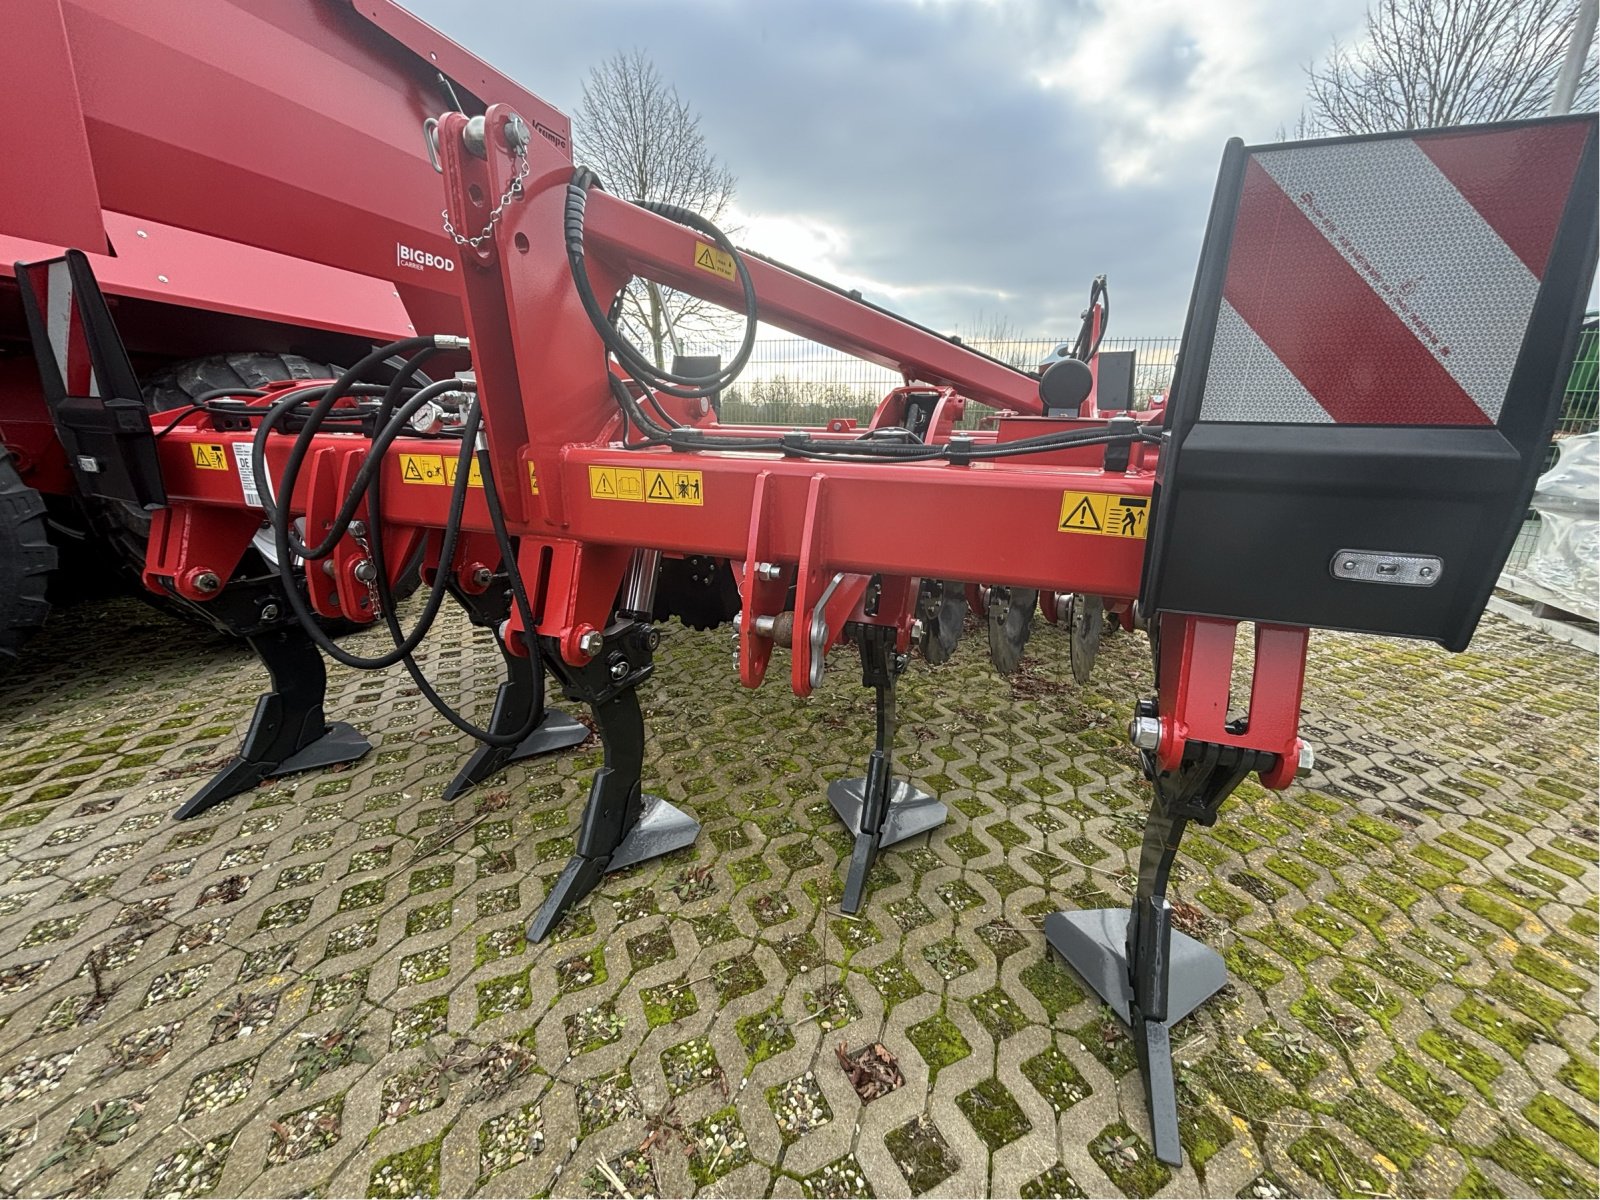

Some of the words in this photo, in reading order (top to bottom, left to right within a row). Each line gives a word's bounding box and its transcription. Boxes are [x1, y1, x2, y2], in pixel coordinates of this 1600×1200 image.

[400, 245, 455, 272] BIGBOD
[400, 259, 424, 271] CARRIER
[240, 458, 250, 468] DE
